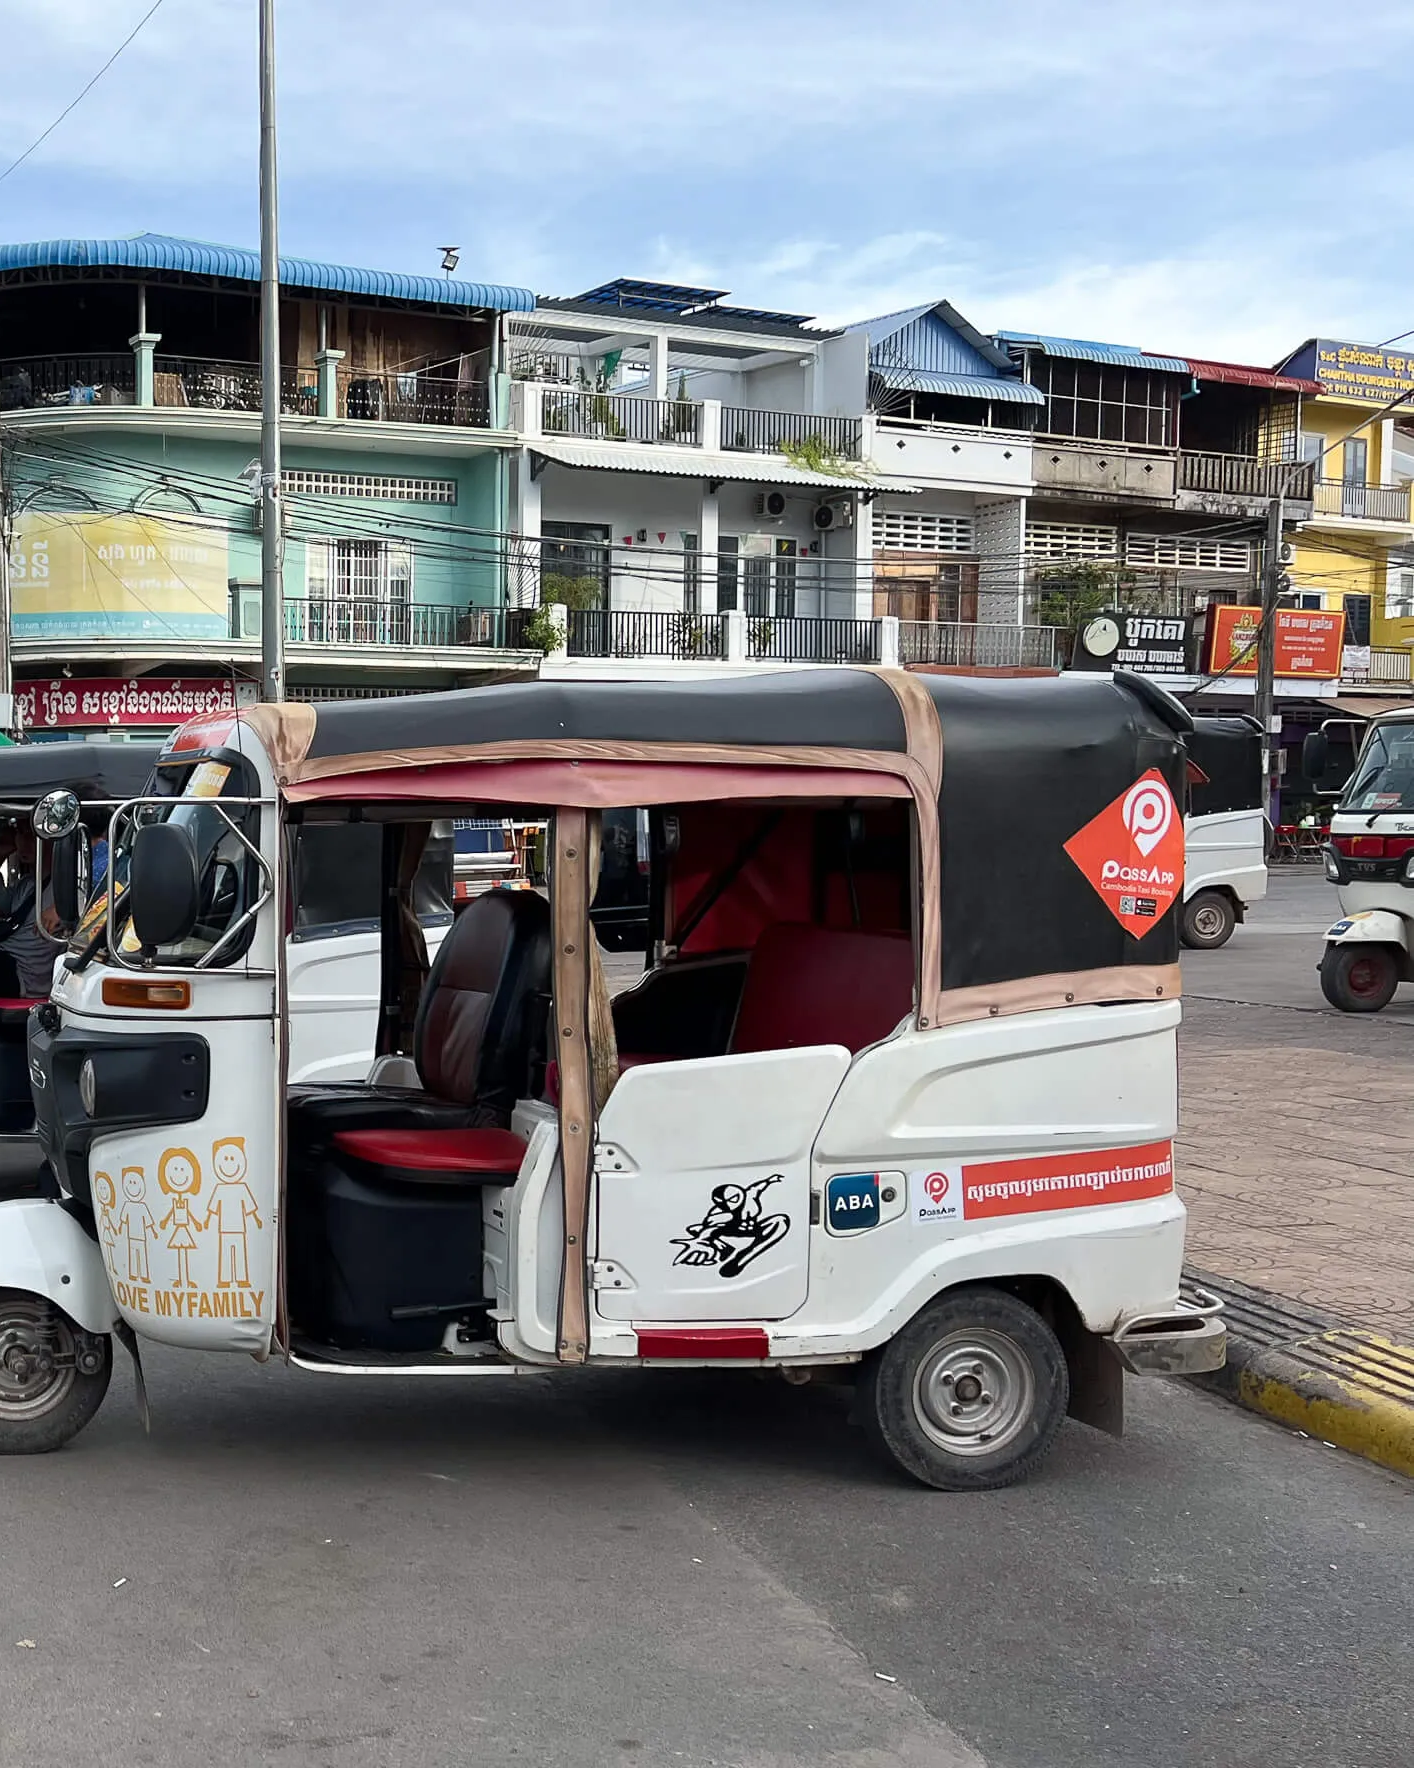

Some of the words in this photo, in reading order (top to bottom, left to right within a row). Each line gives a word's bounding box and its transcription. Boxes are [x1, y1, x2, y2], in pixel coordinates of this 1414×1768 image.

[1102, 860, 1174, 885] PassApp
[1357, 863, 1376, 872] TVS
[1101, 882, 1137, 893] Cambodia
[1138, 886, 1150, 894] Taxi
[1151, 887, 1174, 898] Booking
[835, 1194, 874, 1211] ABA
[919, 1206, 956, 1217] PassApp
